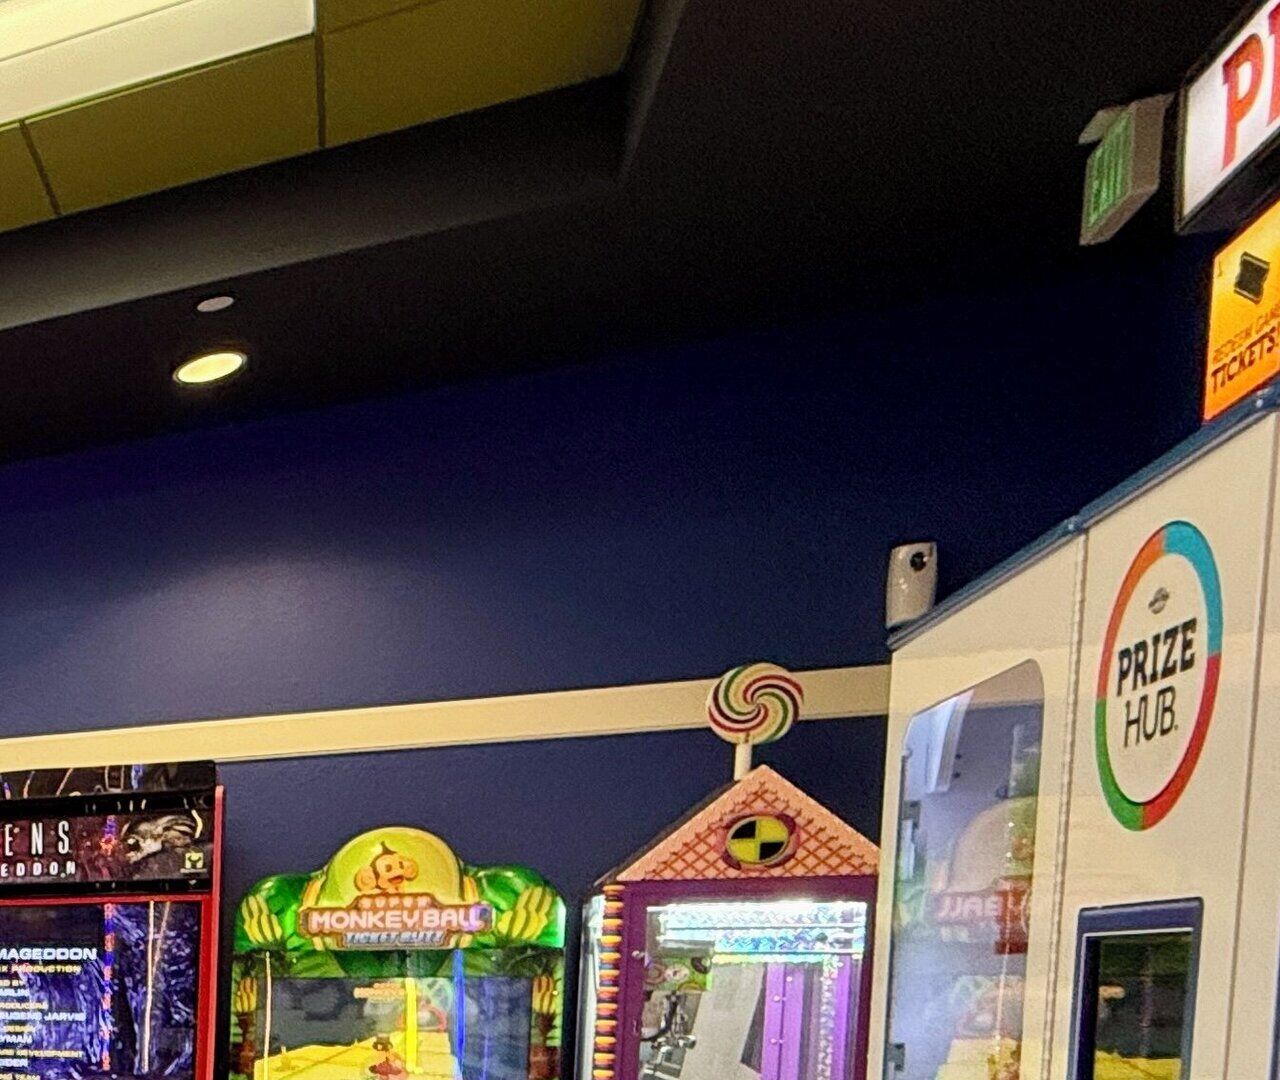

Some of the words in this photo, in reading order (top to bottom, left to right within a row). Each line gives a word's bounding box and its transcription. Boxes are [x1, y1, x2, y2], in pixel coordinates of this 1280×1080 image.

[1116, 618, 1198, 697] PRIZE
[310, 909, 420, 932] MONKEY
[422, 905, 486, 931] BALL
[11, 964, 82, 974] PRODUCTION
